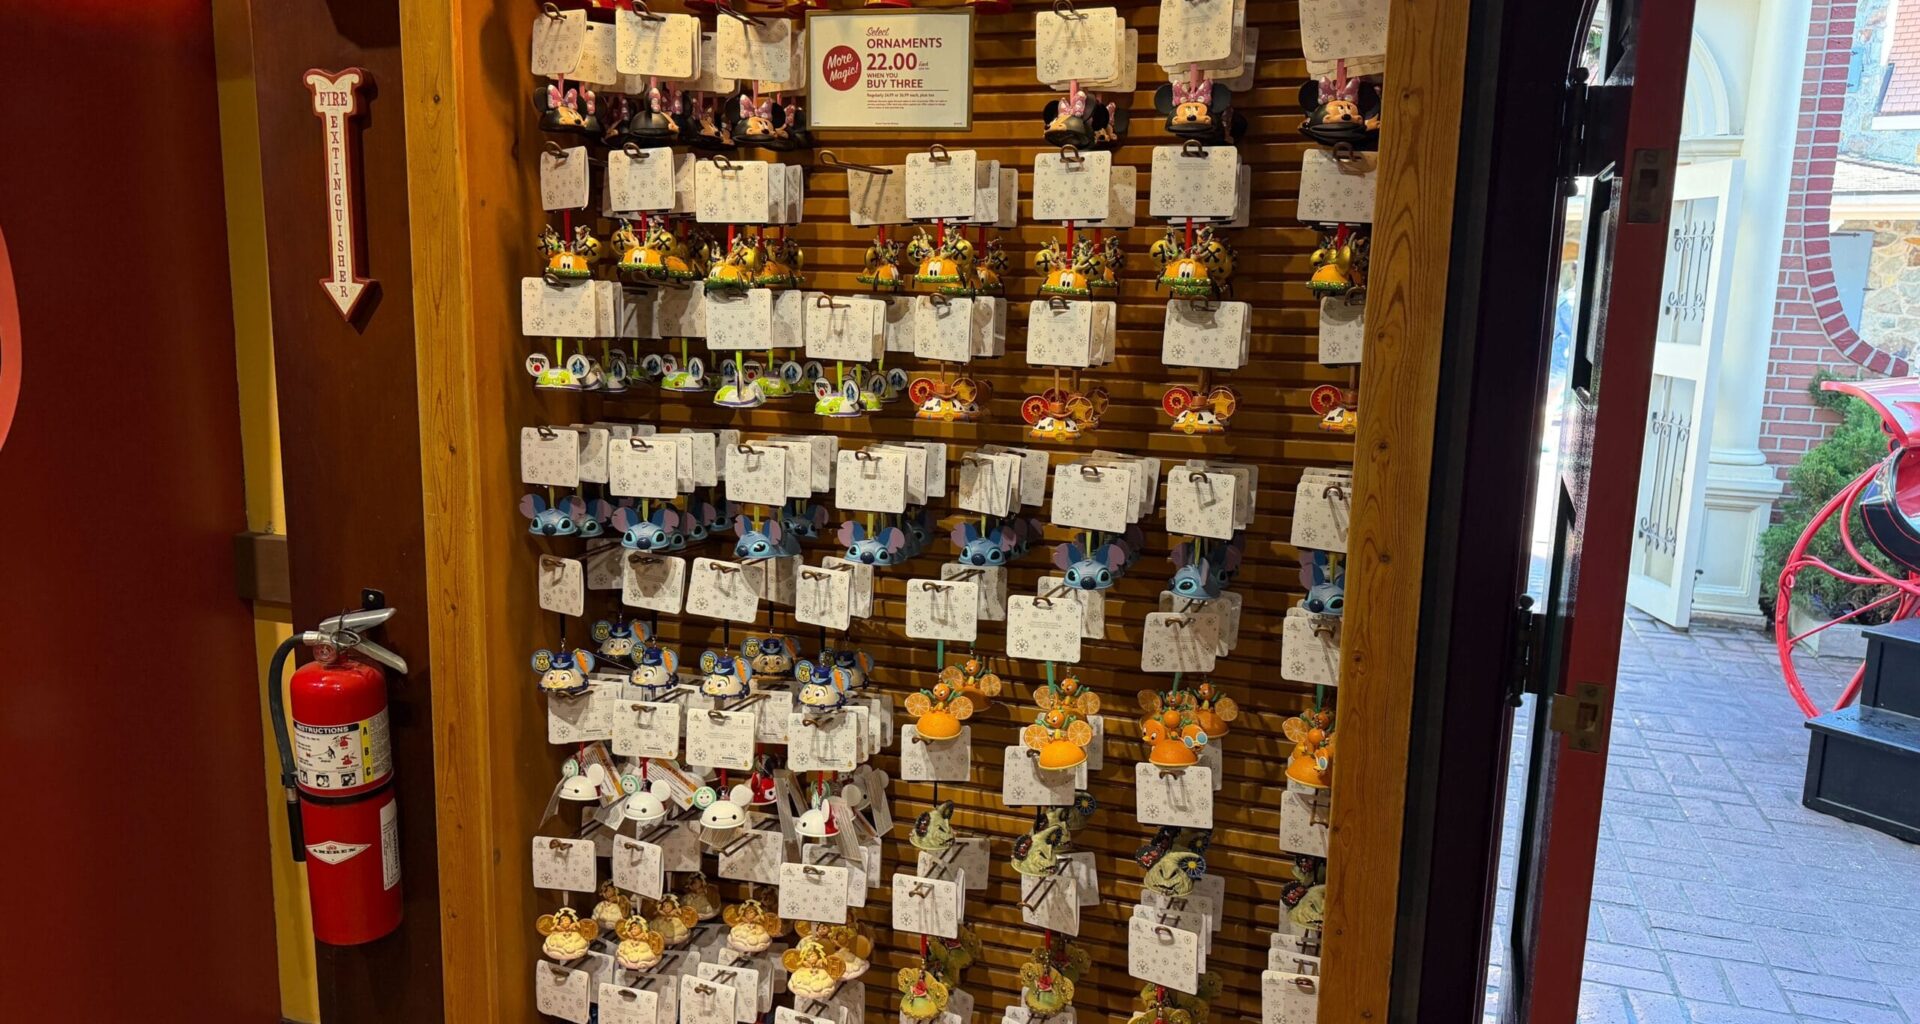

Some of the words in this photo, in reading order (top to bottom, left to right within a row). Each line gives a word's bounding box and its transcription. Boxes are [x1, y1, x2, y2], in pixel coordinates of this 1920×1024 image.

[866, 27, 890, 36] Select
[866, 38, 942, 48] ORNAMENTS
[827, 53, 853, 70] More
[866, 53, 917, 70] 22.00
[829, 62, 859, 84] Magic!
[867, 80, 888, 88] BUY
[891, 79, 923, 88] THREE
[319, 91, 348, 107] FIRE
[330, 115, 349, 298] EXTINGUISHER
[363, 727, 368, 736] A
